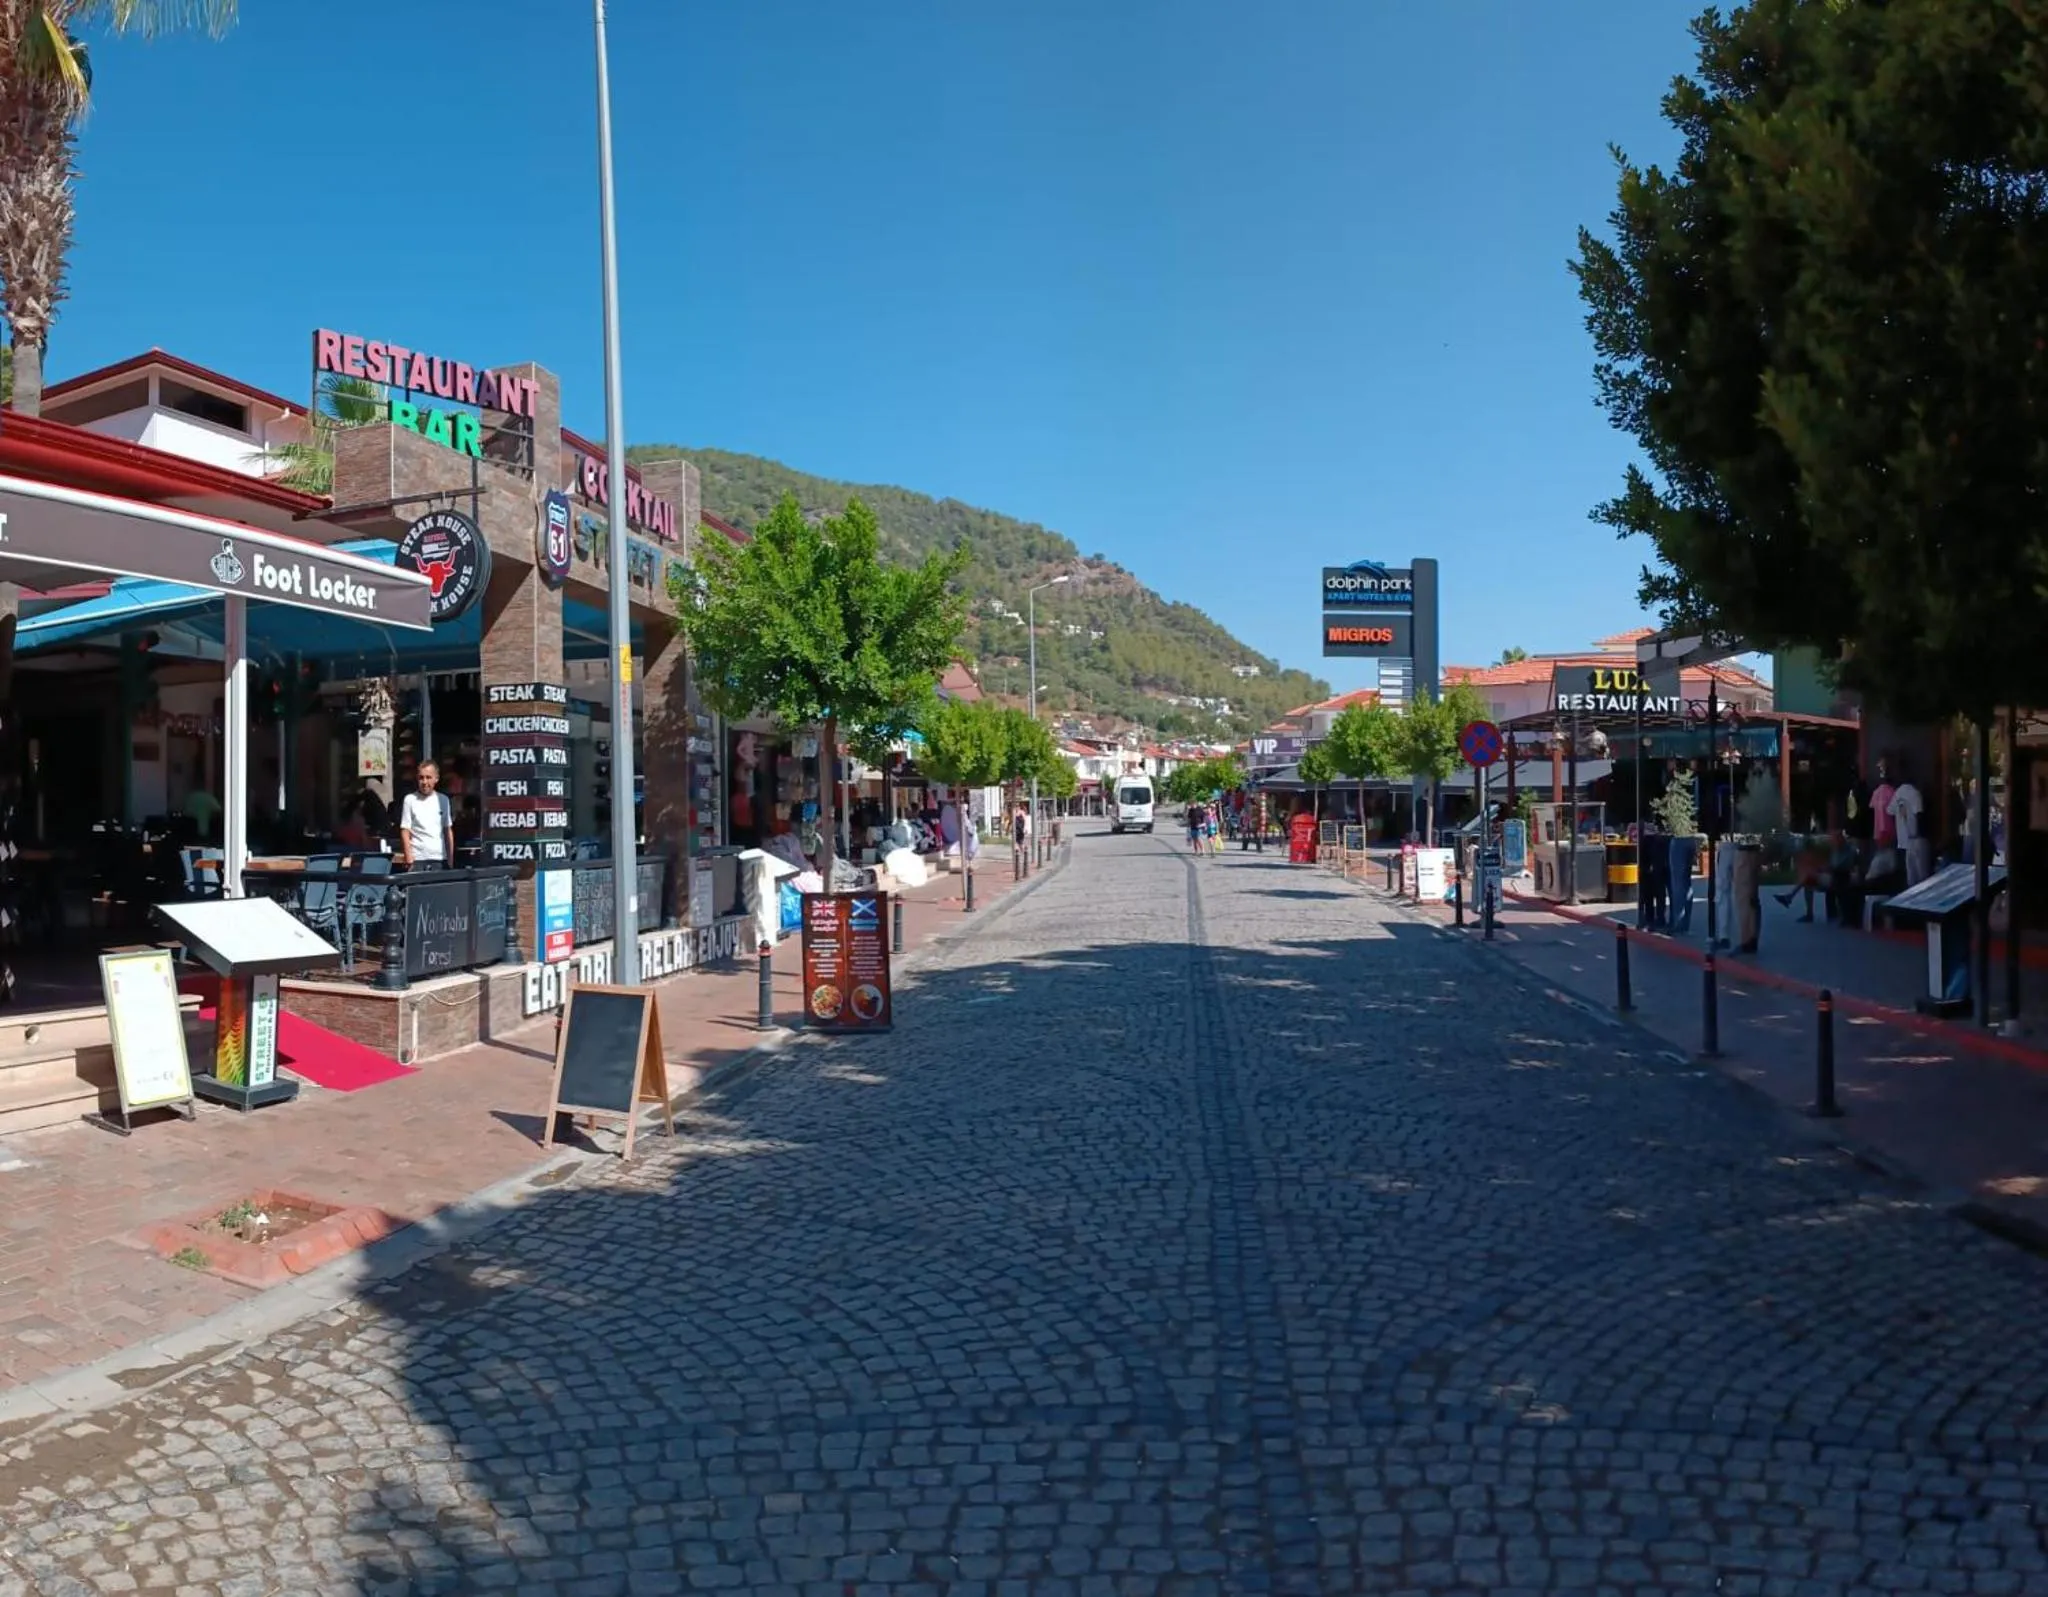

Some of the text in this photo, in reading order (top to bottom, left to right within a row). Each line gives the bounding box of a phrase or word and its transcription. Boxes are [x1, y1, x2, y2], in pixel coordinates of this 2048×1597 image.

[315, 328, 540, 417] RESTAURANT
[390, 400, 482, 459] BAR
[582, 455, 678, 541] COKTAIL
[400, 516, 434, 556] STEAK
[436, 515, 473, 546] HOUSE
[551, 530, 564, 558] 61
[575, 511, 664, 585] STEET
[253, 553, 376, 609] Foot Locker
[1326, 575, 1412, 593] dolphin park
[489, 685, 535, 702] STEAK
[543, 686, 566, 703] STEAK
[1558, 693, 1680, 712] RESTAURANT
[485, 716, 539, 734] CHICKEN
[541, 716, 570, 734] CHICKEN
[1253, 739, 1277, 754] VIP
[489, 748, 536, 765] PASTA
[543, 748, 567, 765] PASTA
[497, 780, 528, 796] FISH
[547, 781, 564, 796] FISH
[489, 812, 537, 828] KEBAB
[543, 811, 567, 828] KEBAB
[493, 844, 534, 860] PIZZA
[545, 843, 566, 858] PIZZA
[525, 962, 570, 1015] EAT
[255, 1015, 267, 1081] STREET
